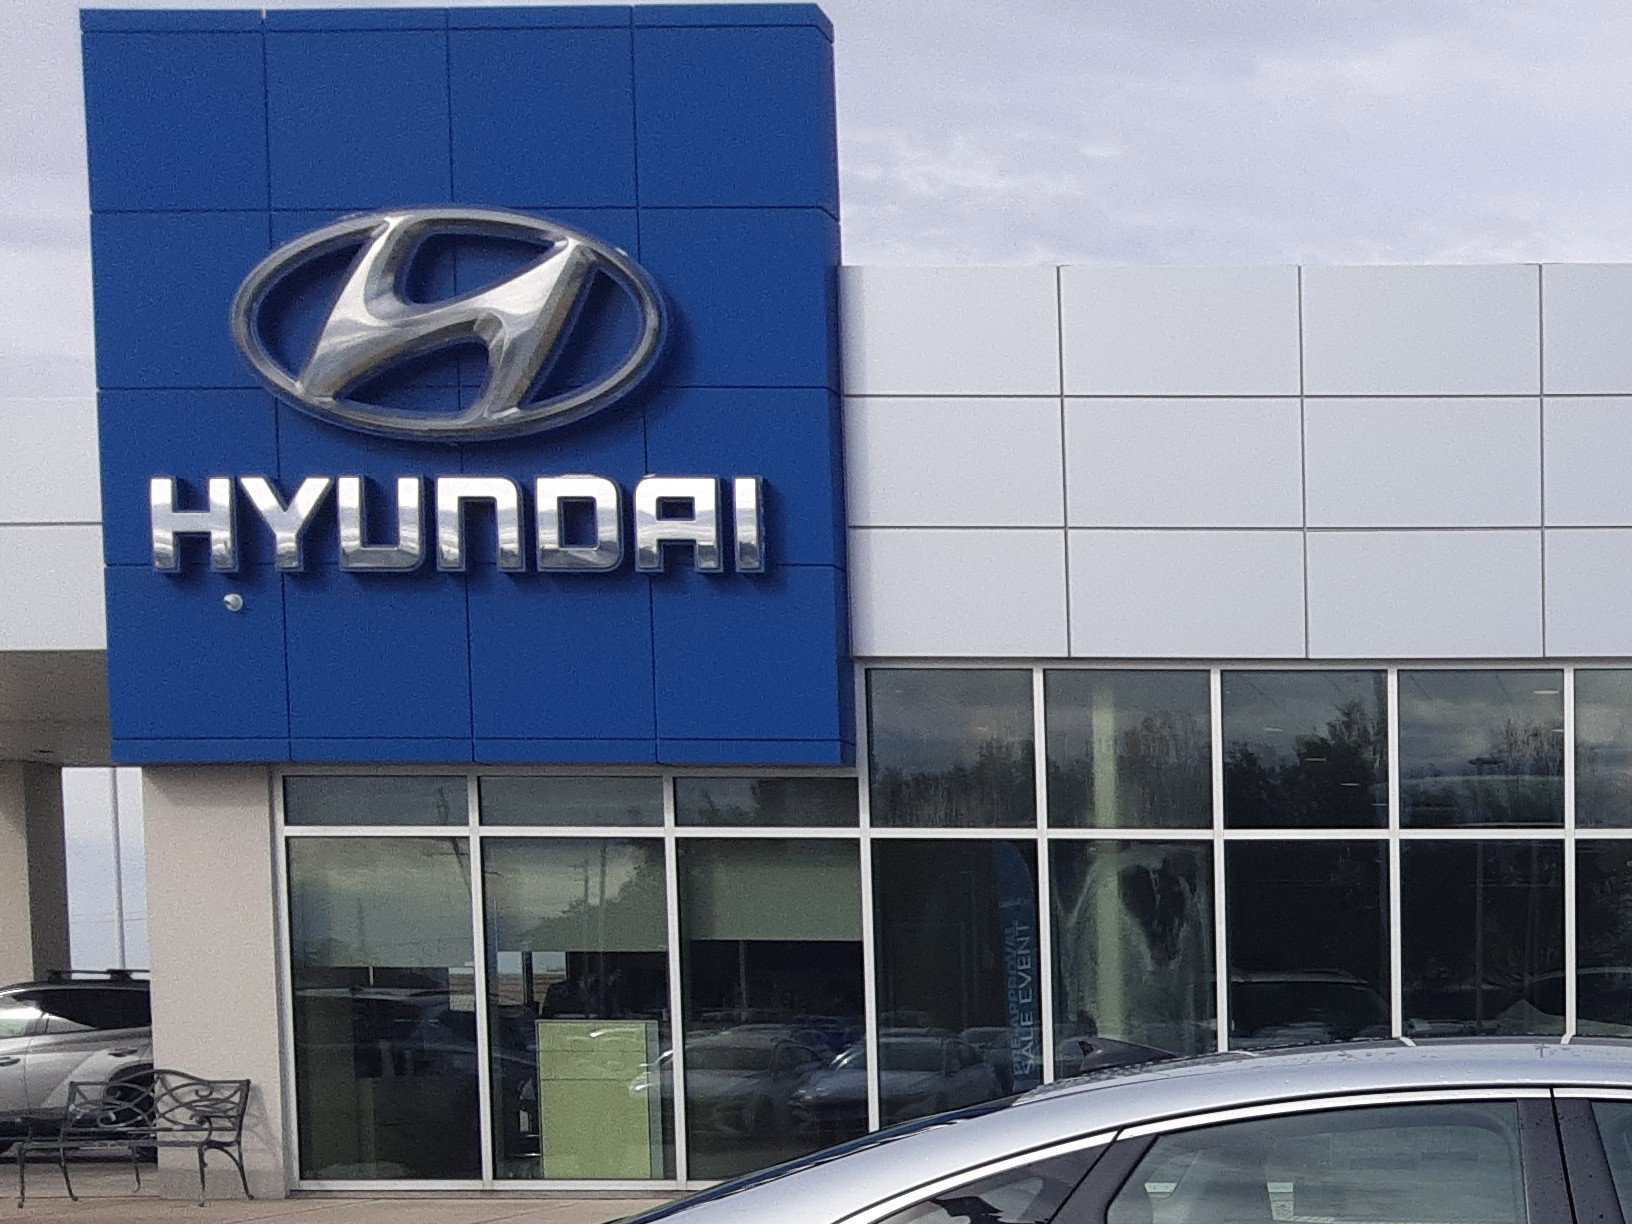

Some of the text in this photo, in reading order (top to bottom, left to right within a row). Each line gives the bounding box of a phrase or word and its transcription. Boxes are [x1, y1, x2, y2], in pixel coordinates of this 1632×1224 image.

[149, 475, 766, 574] HYUNDAI
[1014, 920, 1035, 1075] SALE EVENT
